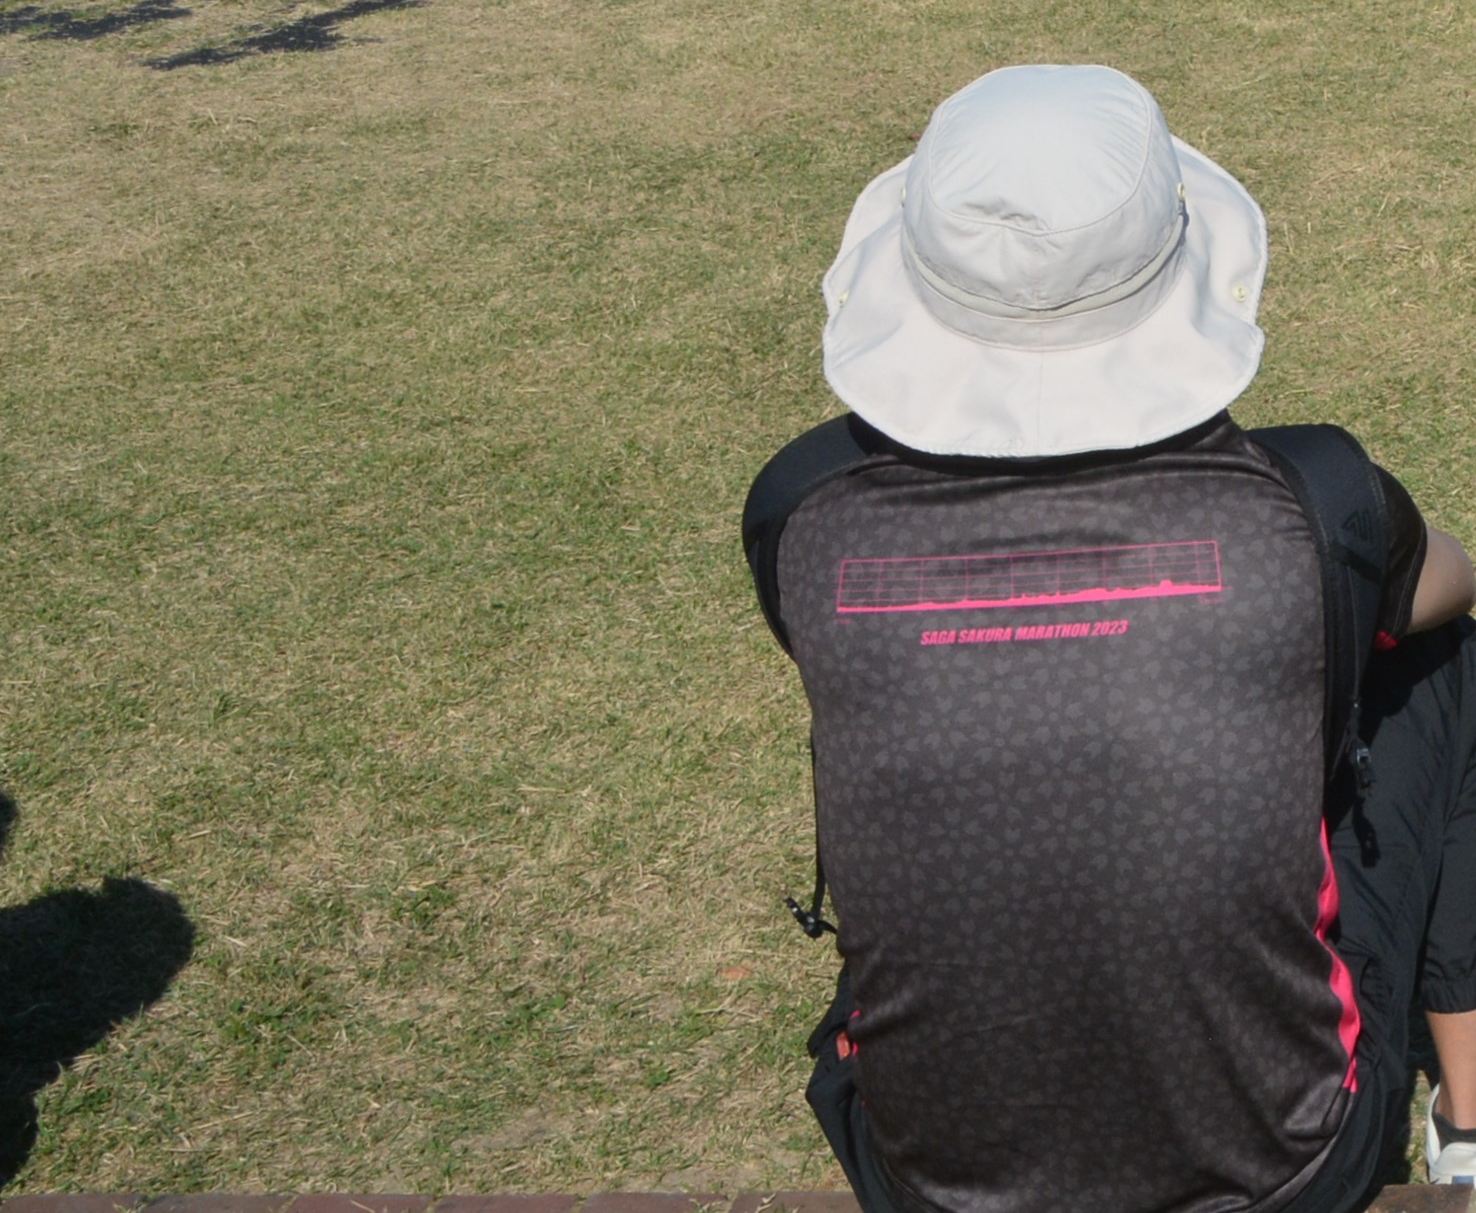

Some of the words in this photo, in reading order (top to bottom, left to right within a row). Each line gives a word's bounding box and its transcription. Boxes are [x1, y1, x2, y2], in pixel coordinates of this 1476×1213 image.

[920, 630, 955, 645] SAGA
[957, 627, 1014, 644] SAKURA
[1015, 622, 1091, 641] MARATHON
[1091, 620, 1129, 636] 2023
